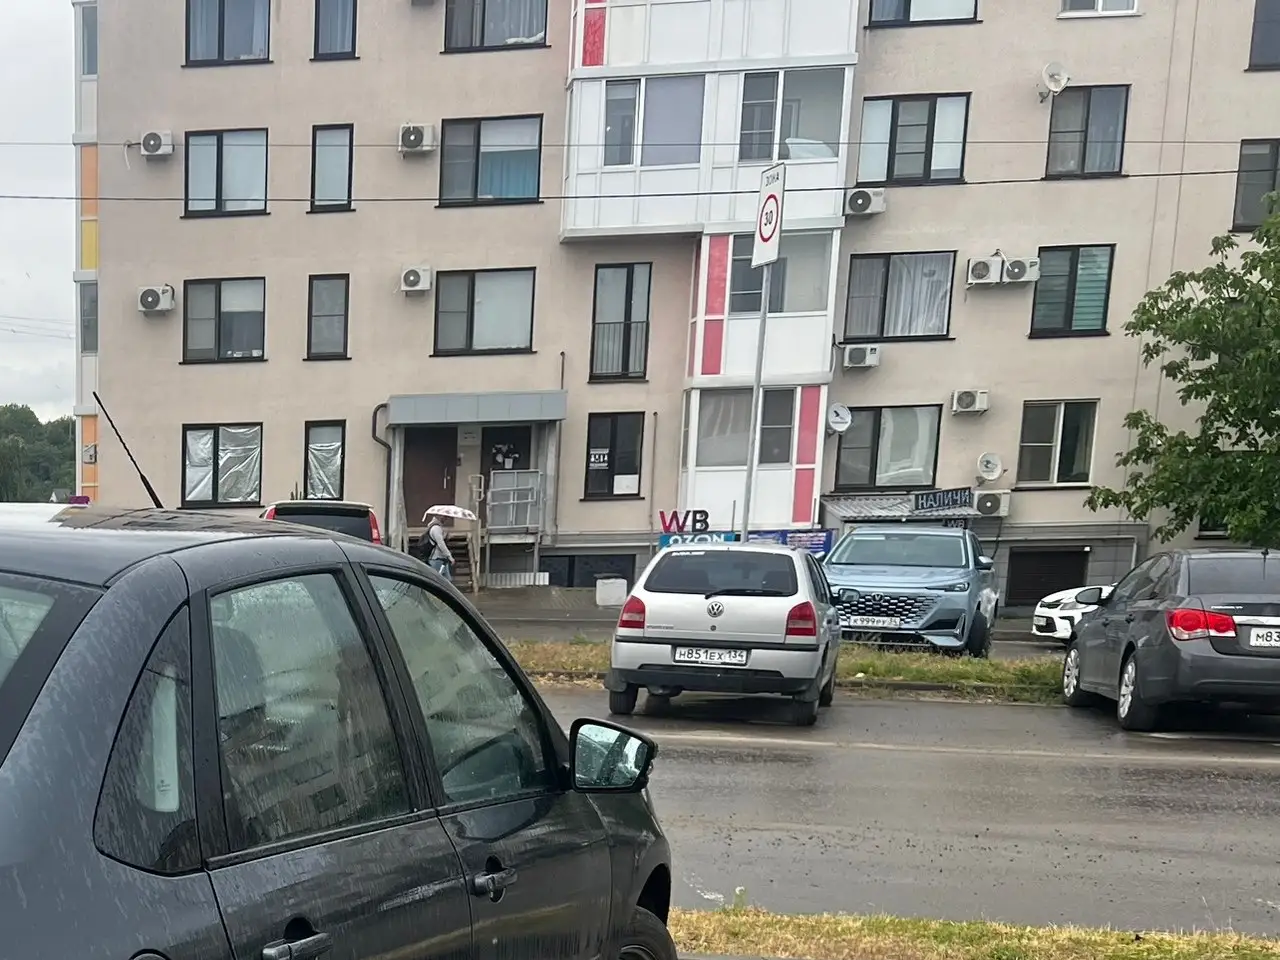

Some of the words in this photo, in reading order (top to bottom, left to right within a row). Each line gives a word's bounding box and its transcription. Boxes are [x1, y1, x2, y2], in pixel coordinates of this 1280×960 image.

[764, 210, 773, 226] 30
[659, 509, 710, 533] WB
[726, 650, 744, 659] 134
